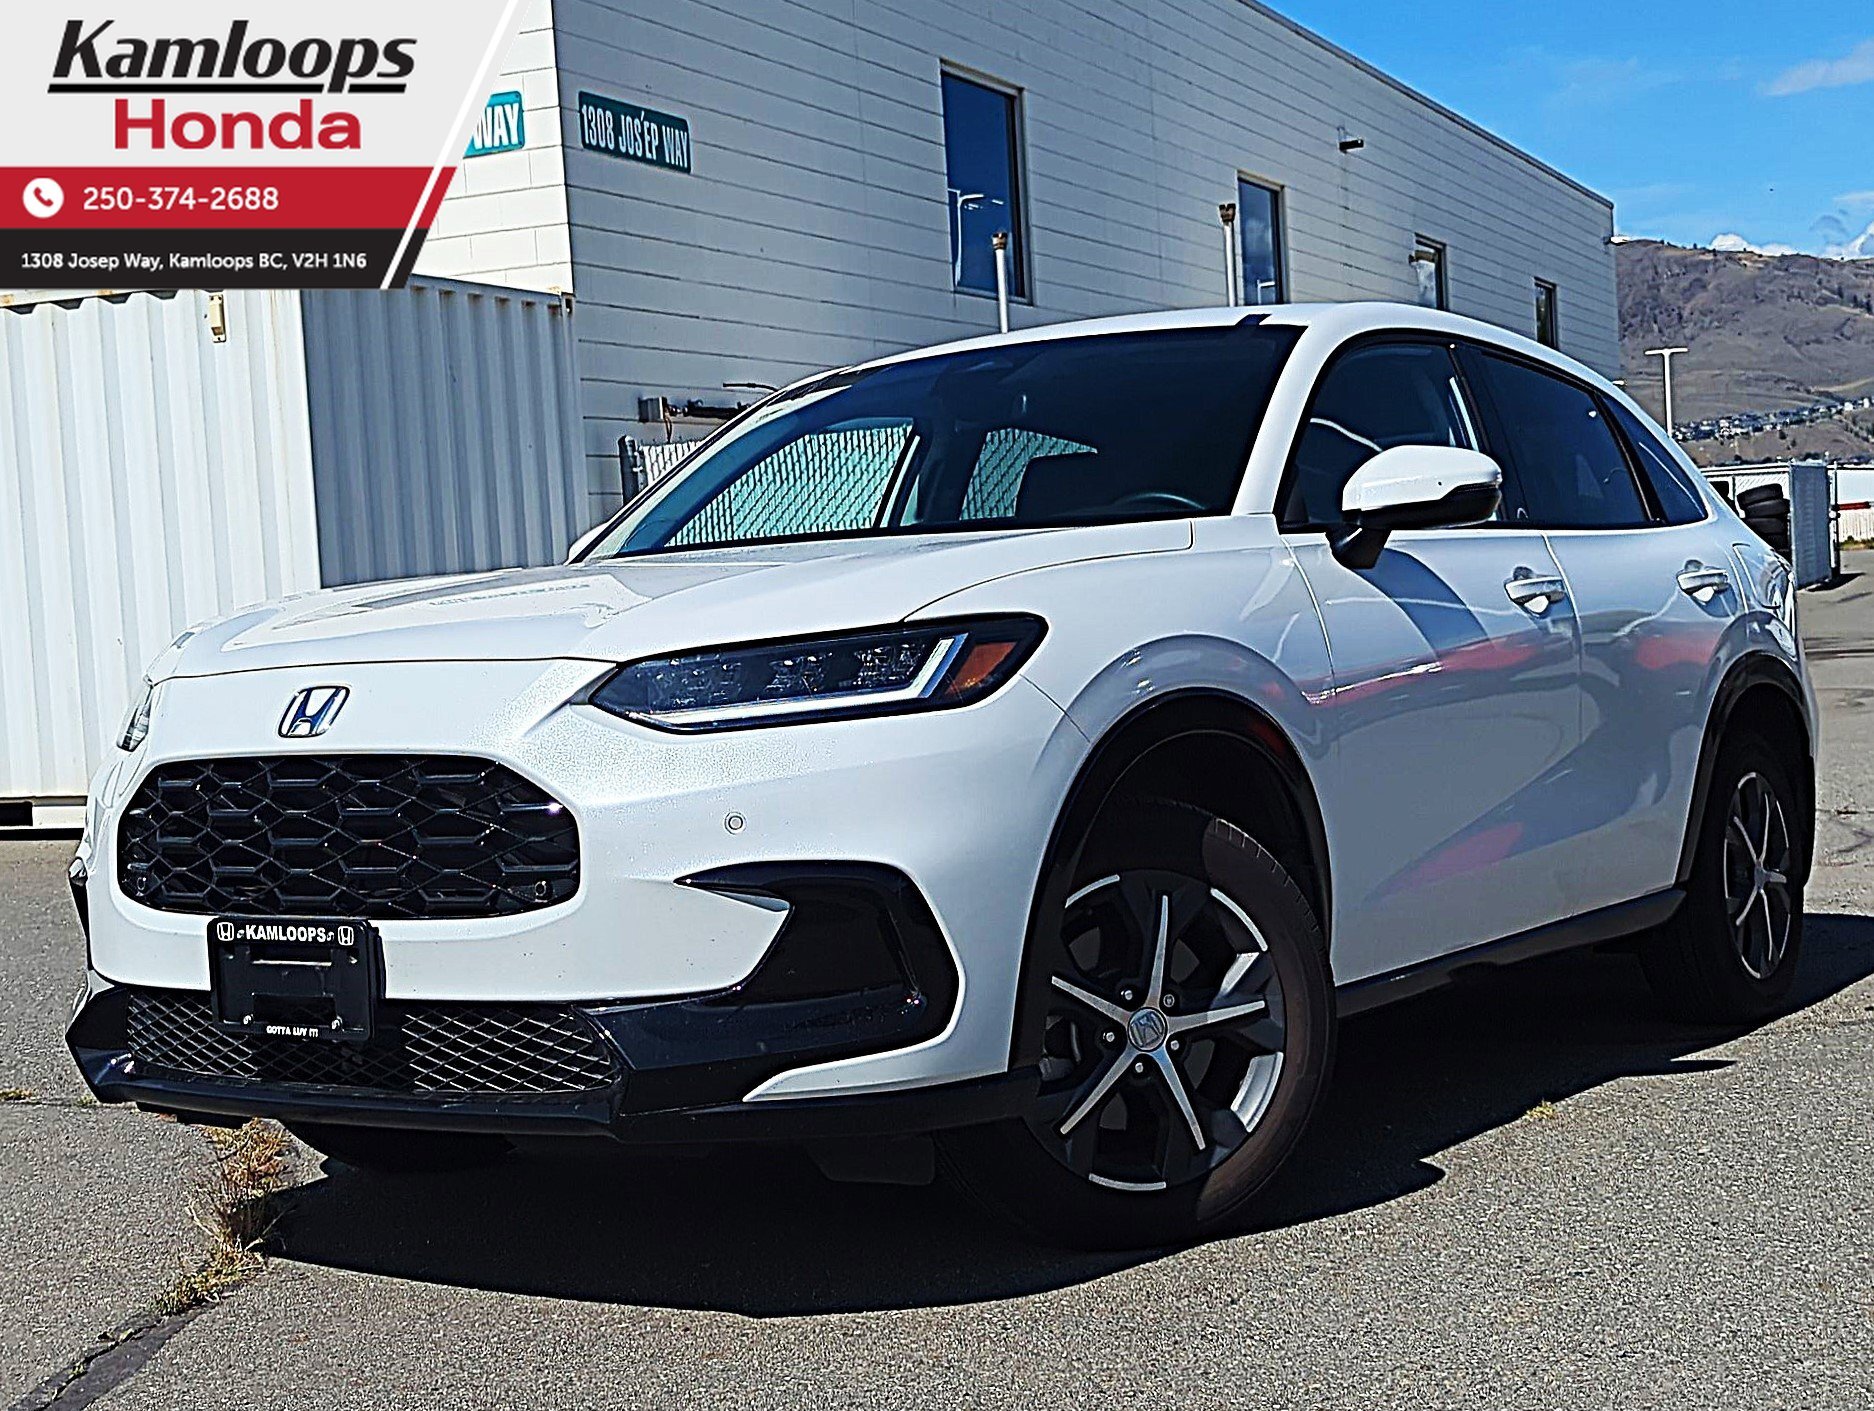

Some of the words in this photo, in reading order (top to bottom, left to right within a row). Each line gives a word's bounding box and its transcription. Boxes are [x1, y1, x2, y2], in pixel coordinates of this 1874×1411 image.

[473, 103, 519, 149] WAY
[581, 104, 615, 149] 1308
[662, 125, 687, 168] WAY
[245, 924, 327, 943] KAMLOOPS
